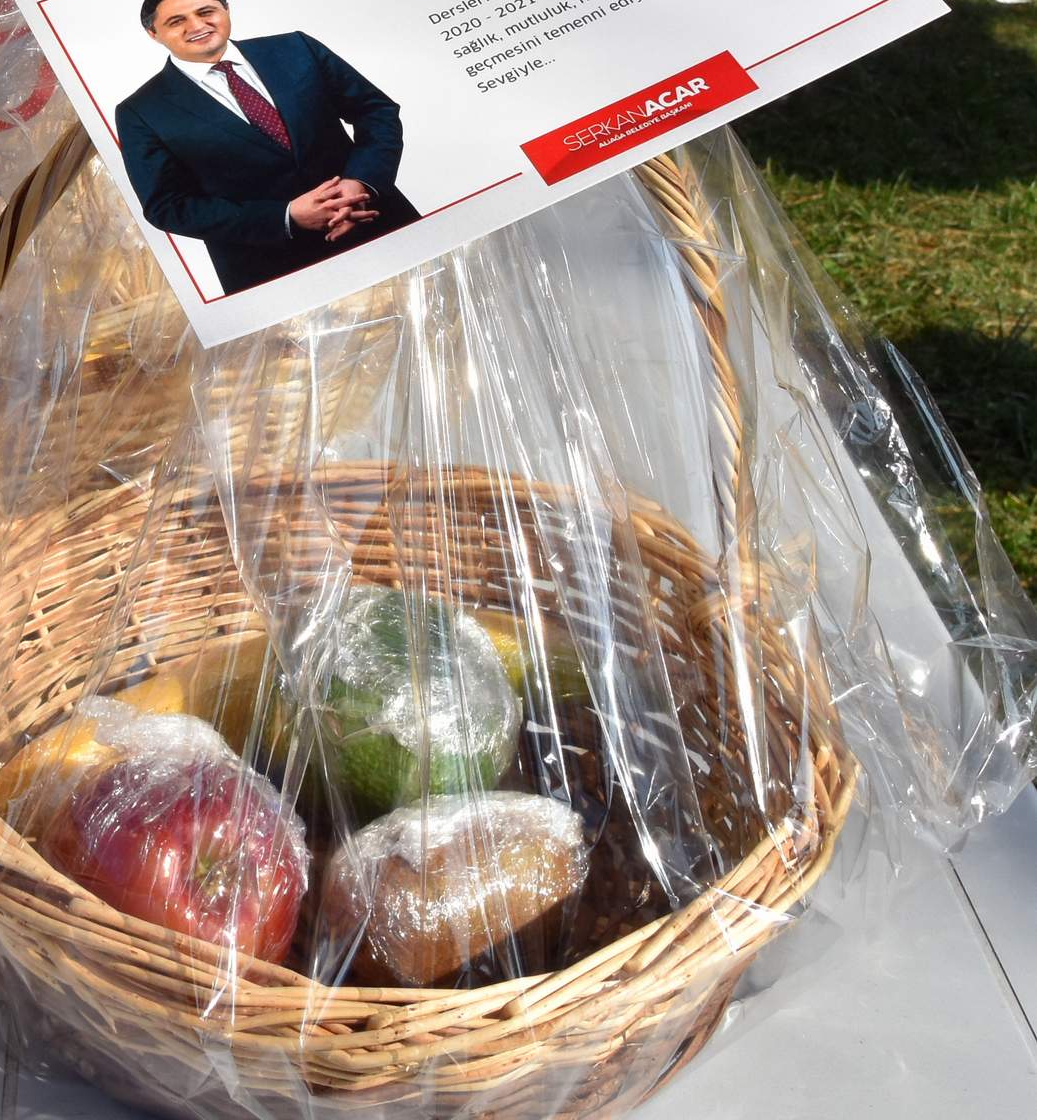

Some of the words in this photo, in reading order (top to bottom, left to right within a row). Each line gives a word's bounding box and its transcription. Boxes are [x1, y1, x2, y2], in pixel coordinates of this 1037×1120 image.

[438, 16, 483, 43] 2020
[452, 32, 505, 60] sağlık,
[503, 0, 578, 38] mutluluk,
[464, 34, 543, 79] geçmesini
[542, 4, 608, 42] temenni
[475, 57, 557, 95] Sevgiyle...
